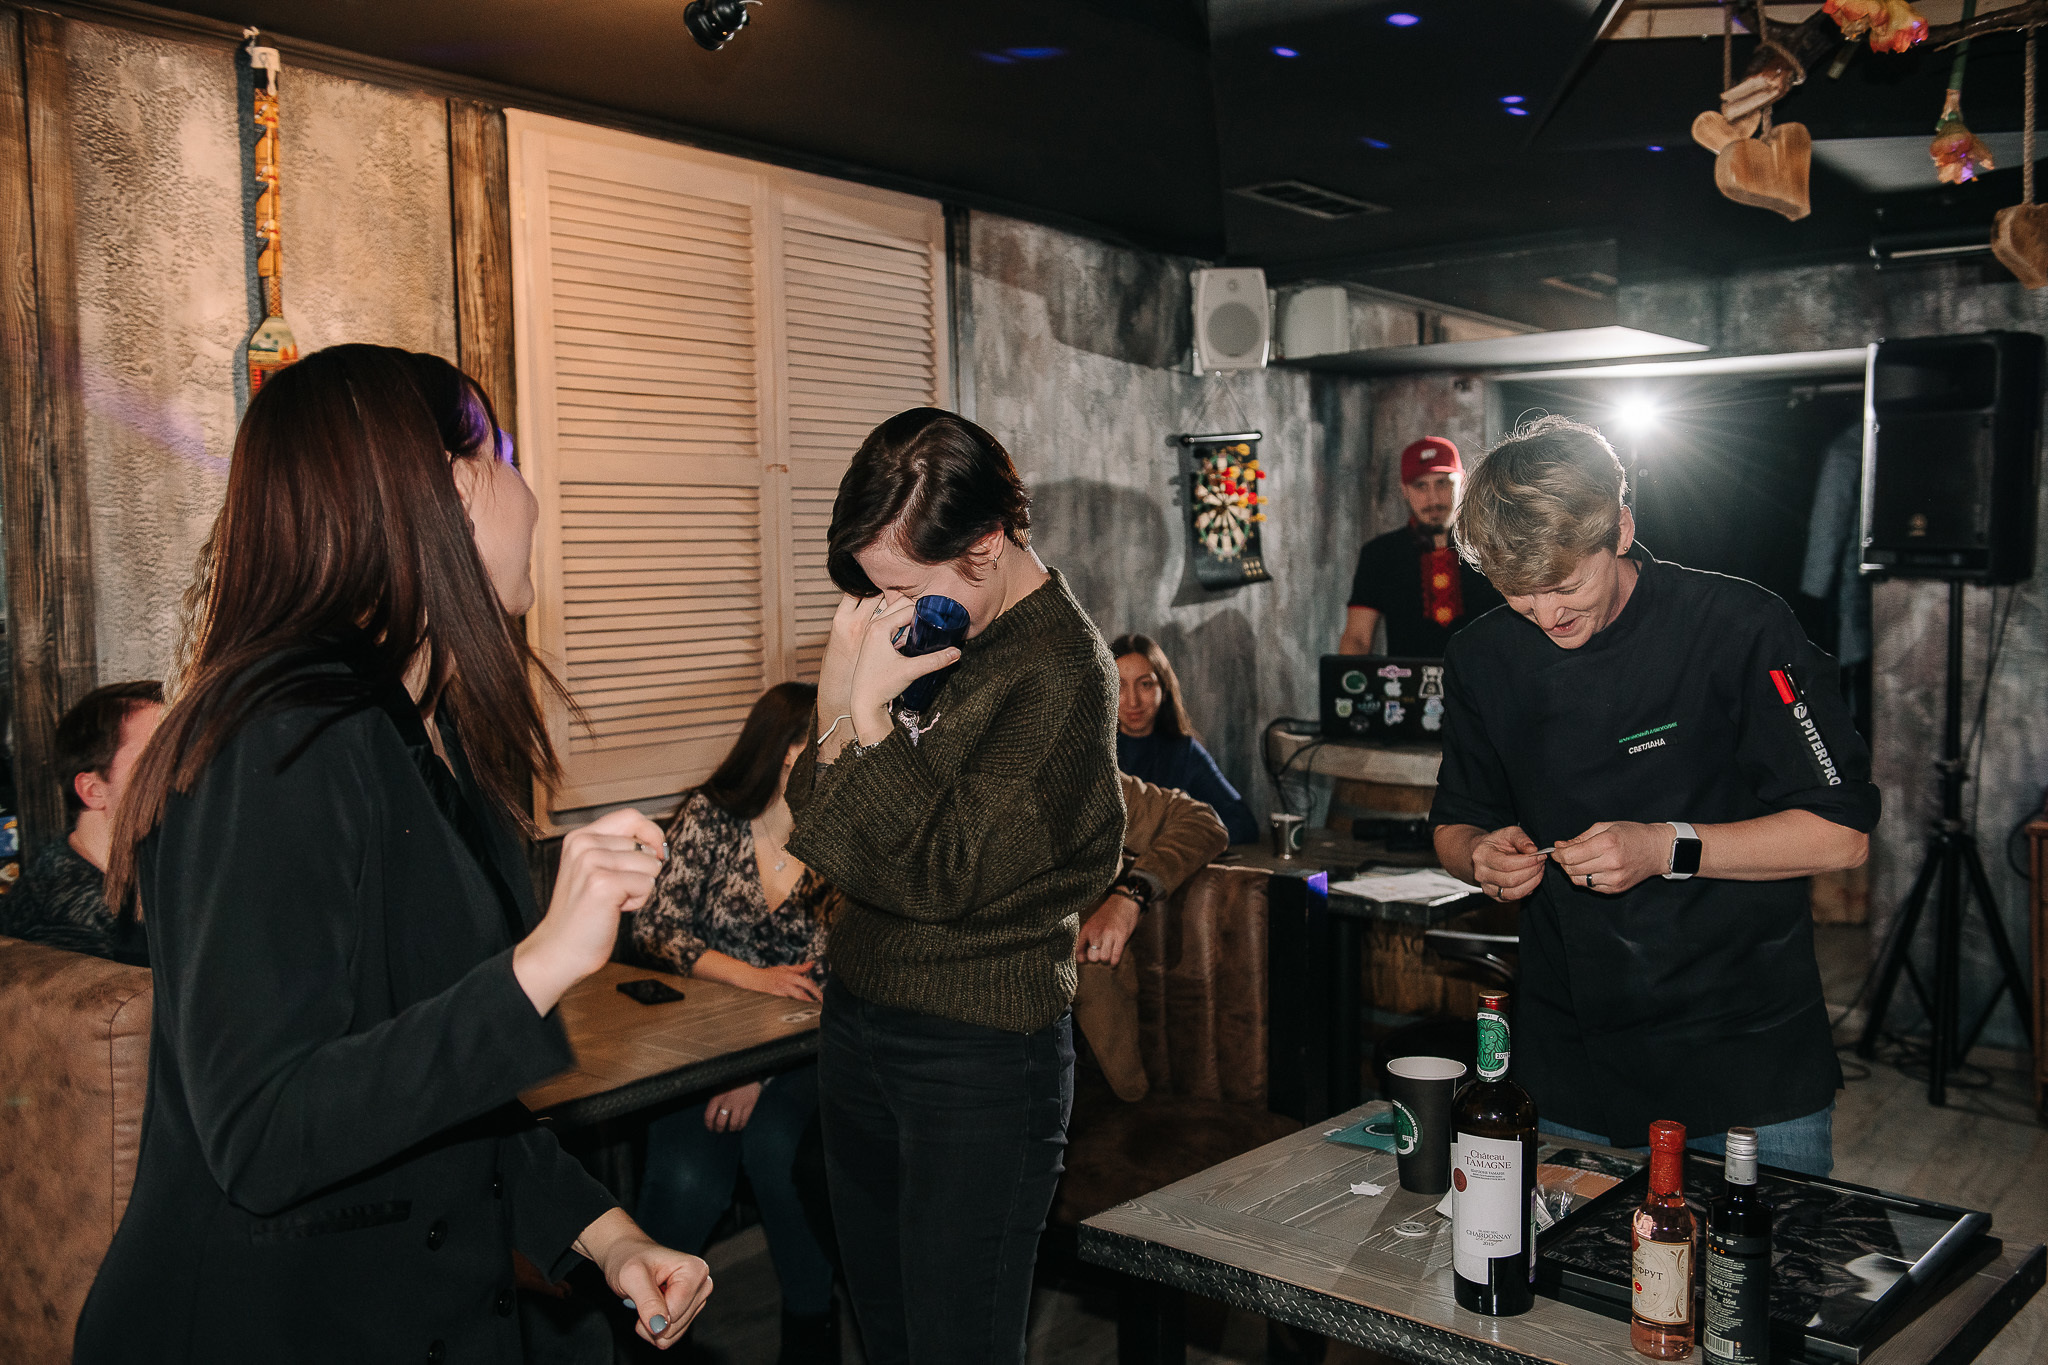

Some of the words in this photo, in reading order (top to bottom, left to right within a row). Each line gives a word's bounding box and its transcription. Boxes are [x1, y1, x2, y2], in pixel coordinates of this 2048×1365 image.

[1628, 737, 1666, 755] СВЕТЛАНА
[1800, 718, 1842, 786] PITERPRO
[1464, 1155, 1512, 1169] TAMAGNE
[1465, 1229, 1512, 1240] CHARDONNAY
